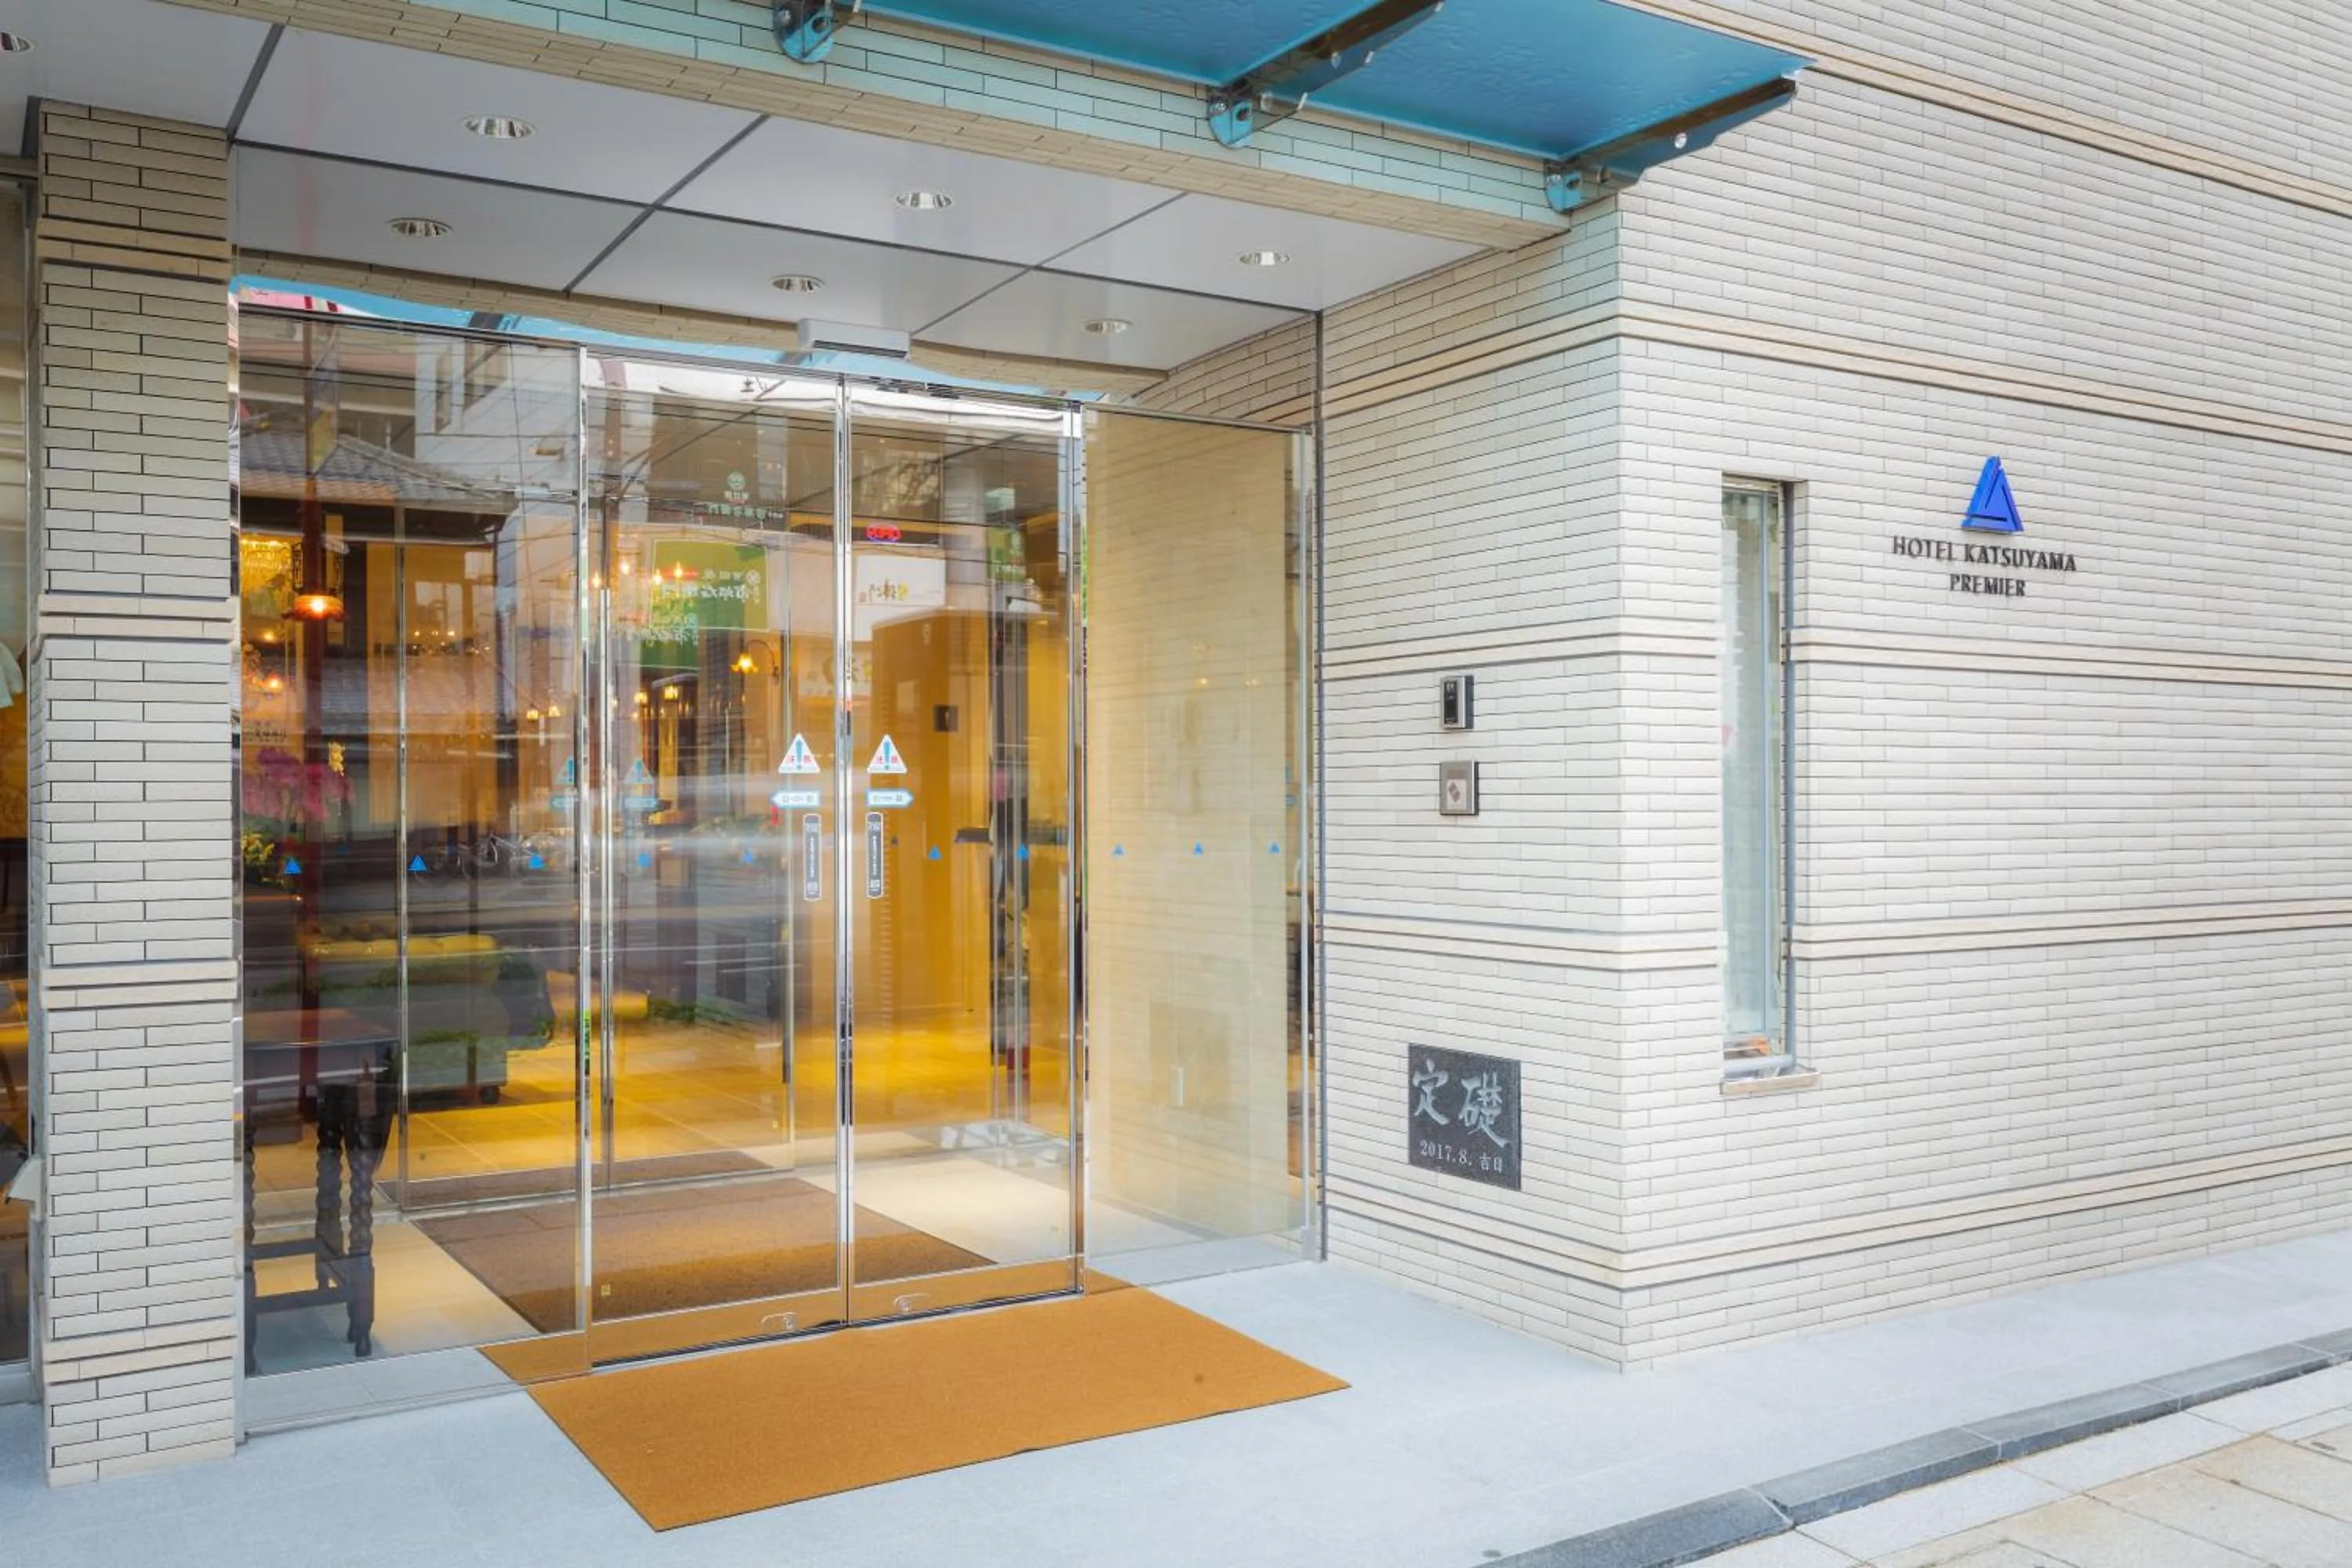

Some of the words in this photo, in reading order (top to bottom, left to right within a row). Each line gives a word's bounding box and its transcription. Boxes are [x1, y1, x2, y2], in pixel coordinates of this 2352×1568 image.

[1893, 535, 1957, 561] HOTEL
[1964, 543, 2077, 572] KATSUYAMA
[1950, 573, 2026, 597] PREMIER
